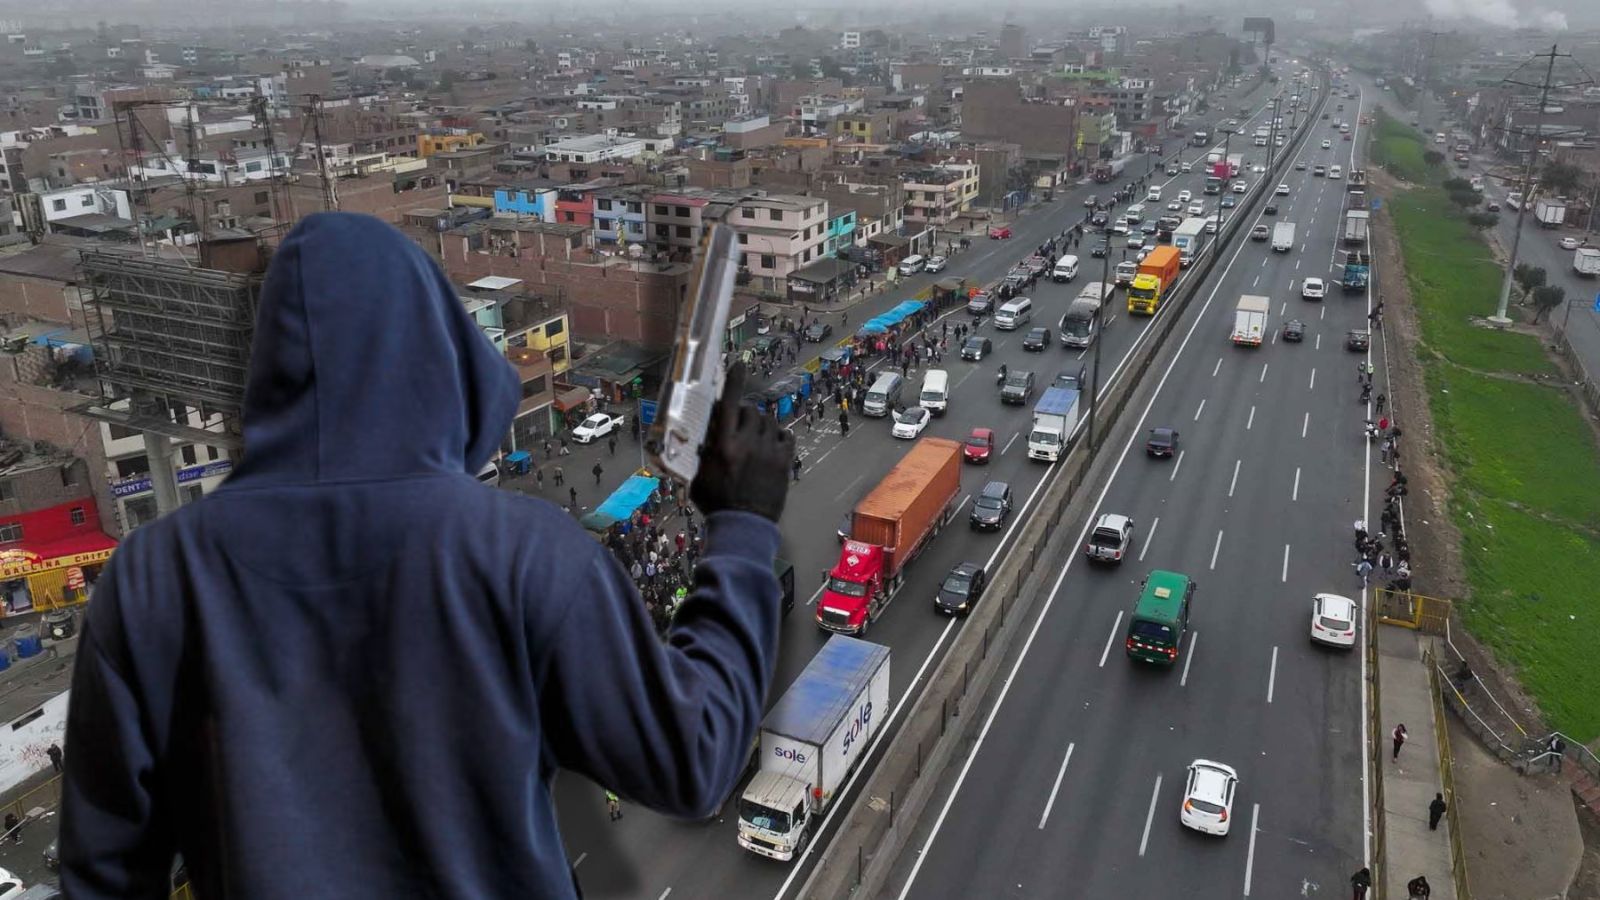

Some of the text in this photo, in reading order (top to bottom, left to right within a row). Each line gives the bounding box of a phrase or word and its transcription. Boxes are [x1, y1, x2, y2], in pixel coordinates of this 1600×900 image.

[75, 551, 110, 563] CHIFA
[843, 701, 872, 755] sole
[775, 746, 805, 763] sole
